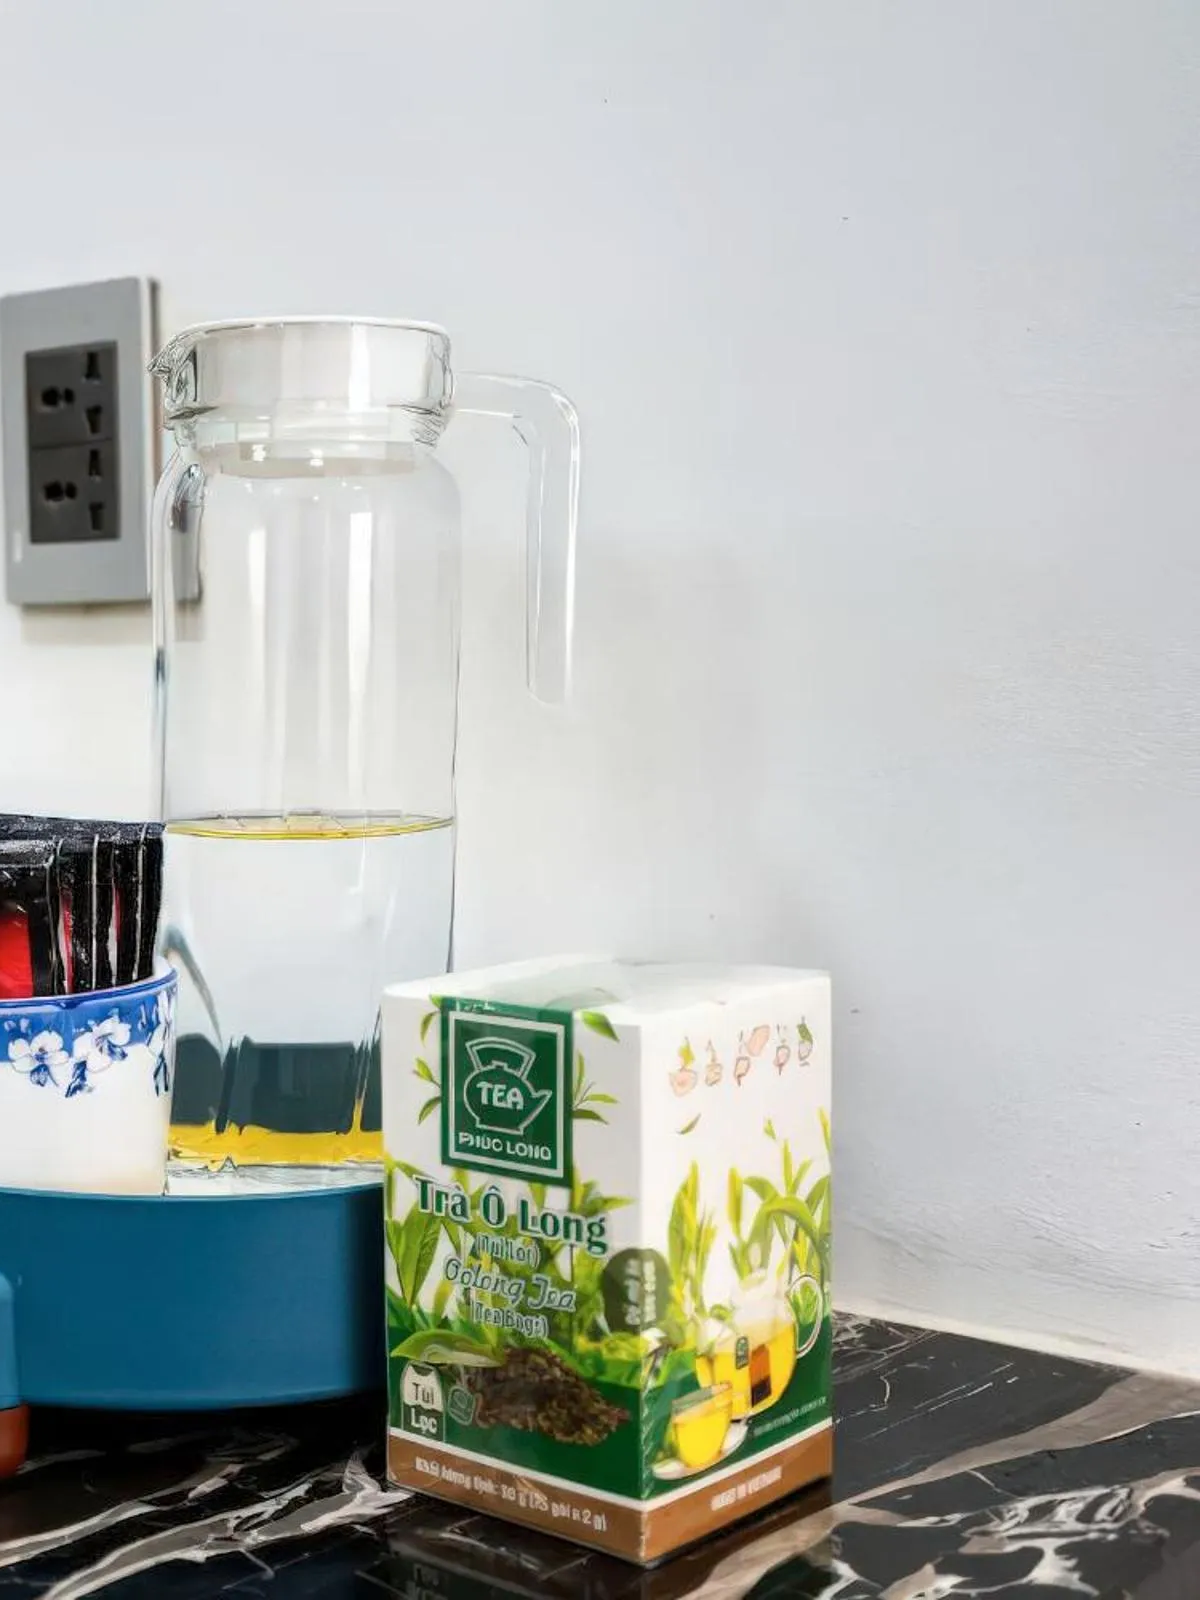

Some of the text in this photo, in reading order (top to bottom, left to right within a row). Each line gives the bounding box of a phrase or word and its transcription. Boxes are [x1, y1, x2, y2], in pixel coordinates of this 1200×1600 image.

[476, 1081, 524, 1110] TEA
[506, 1141, 551, 1160] LONG
[413, 1175, 608, 1256] Trà Ô Long
[446, 1257, 525, 1302] Oolong
[528, 1274, 576, 1312] Tea
